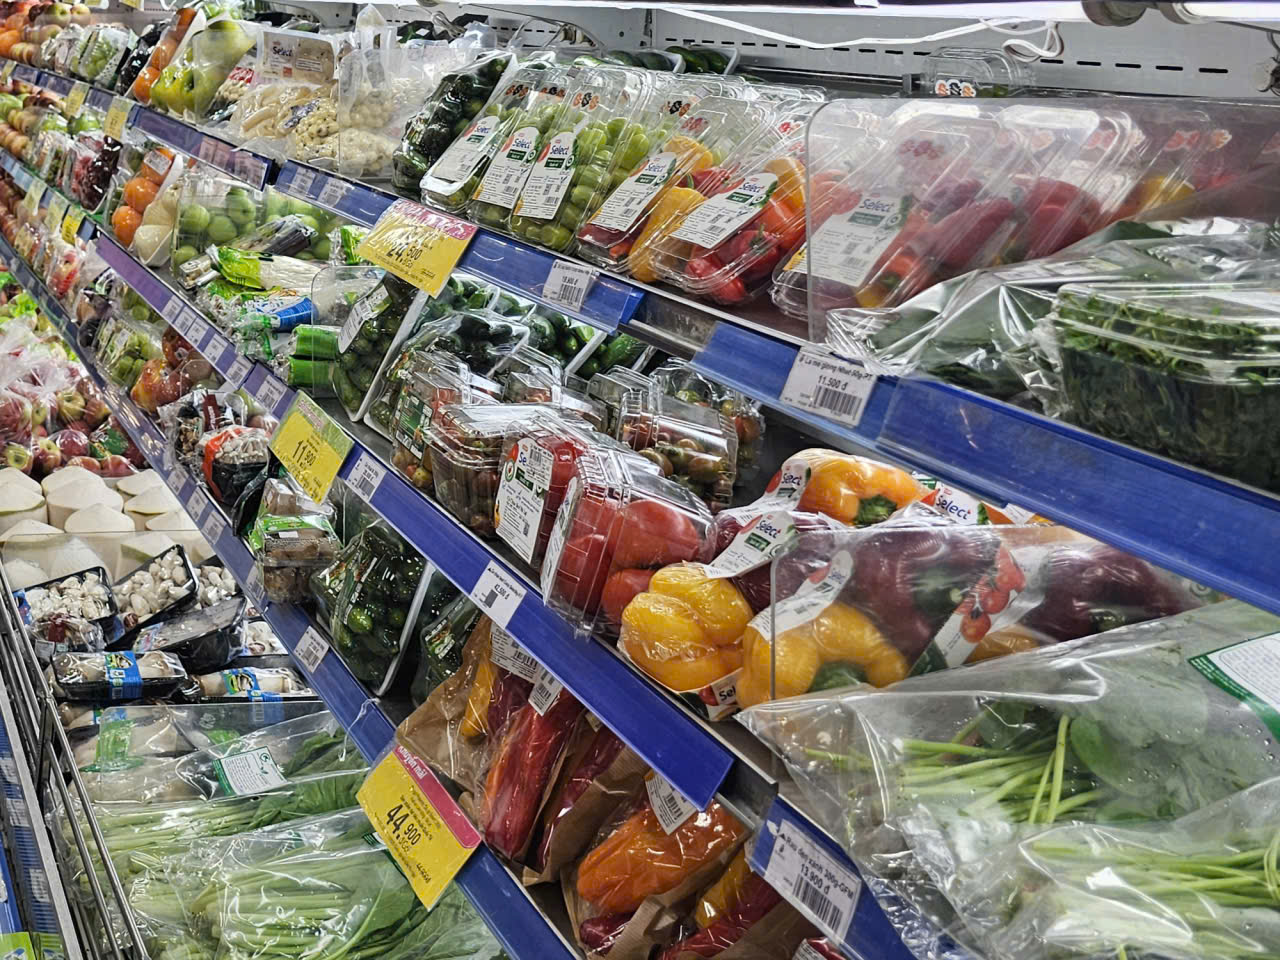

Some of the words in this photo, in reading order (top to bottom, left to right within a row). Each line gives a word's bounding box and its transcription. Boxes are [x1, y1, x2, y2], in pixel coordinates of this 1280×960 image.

[272, 46, 293, 57] Select
[512, 137, 533, 150] Select
[549, 144, 570, 156] Select
[644, 162, 667, 173] Select
[739, 182, 766, 194] Select
[858, 198, 895, 213] Select
[818, 375, 841, 389] 11.500
[935, 495, 971, 520] Select
[756, 520, 782, 539] Select
